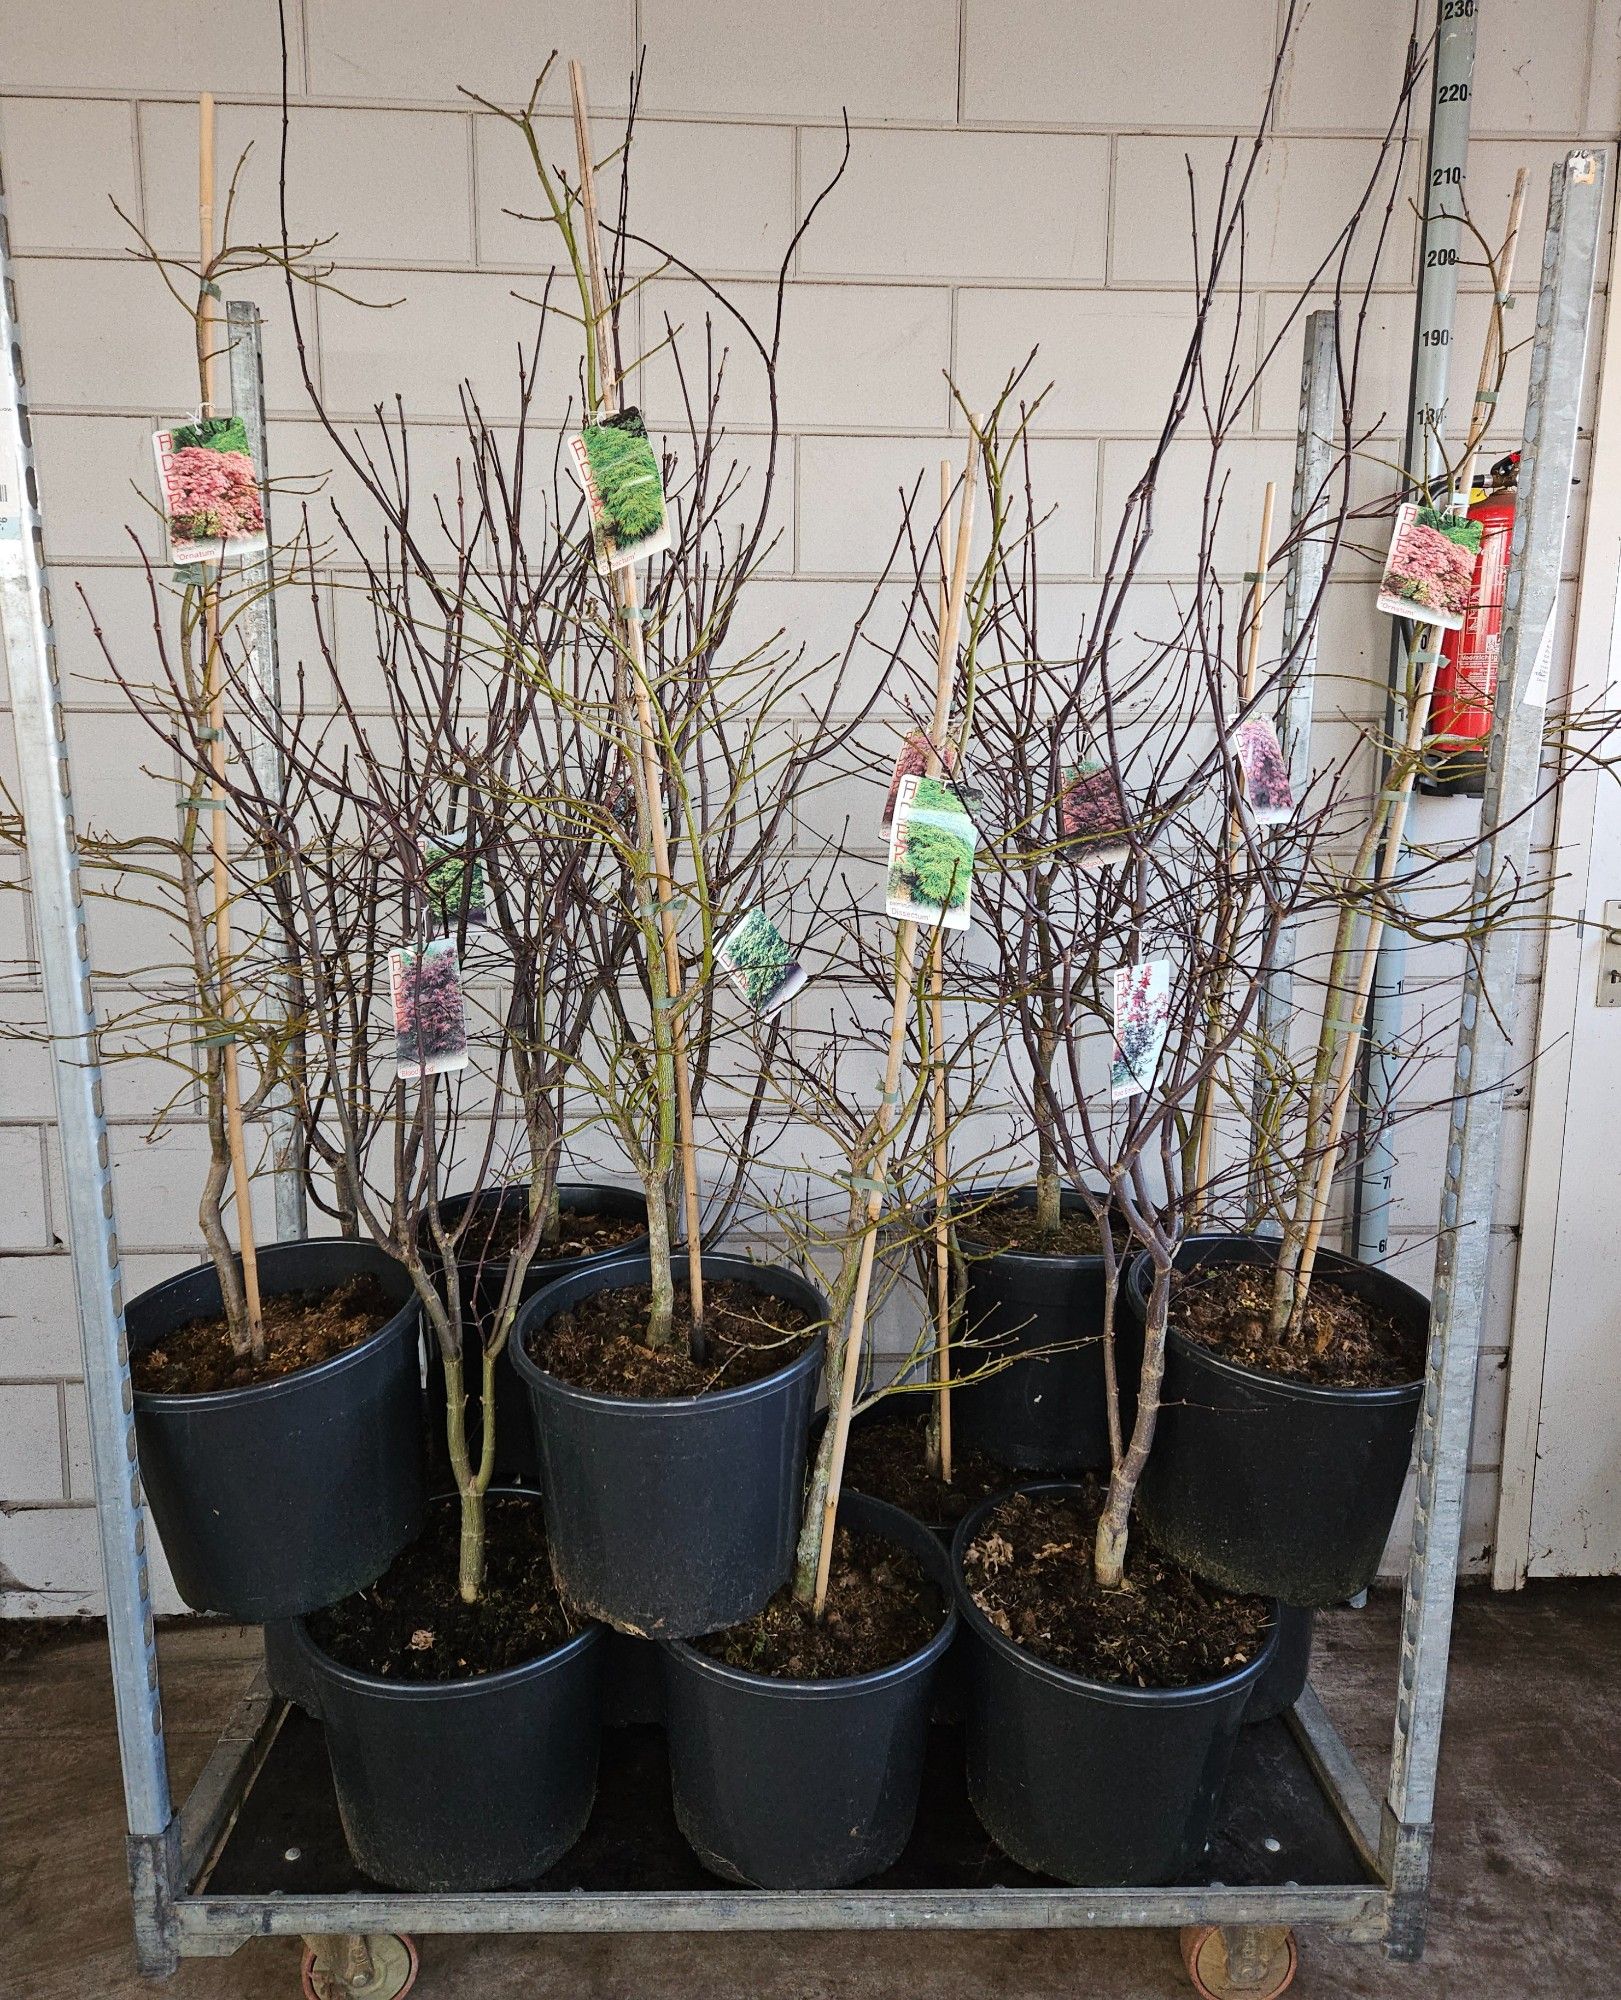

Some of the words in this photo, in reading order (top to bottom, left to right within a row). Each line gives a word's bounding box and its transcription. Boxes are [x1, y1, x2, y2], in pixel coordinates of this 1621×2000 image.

[1444, 0, 1475, 20] 230
[1439, 84, 1469, 103] 220
[1433, 166, 1462, 186] 210
[1427, 247, 1458, 267] 200
[1422, 328, 1450, 347] 190
